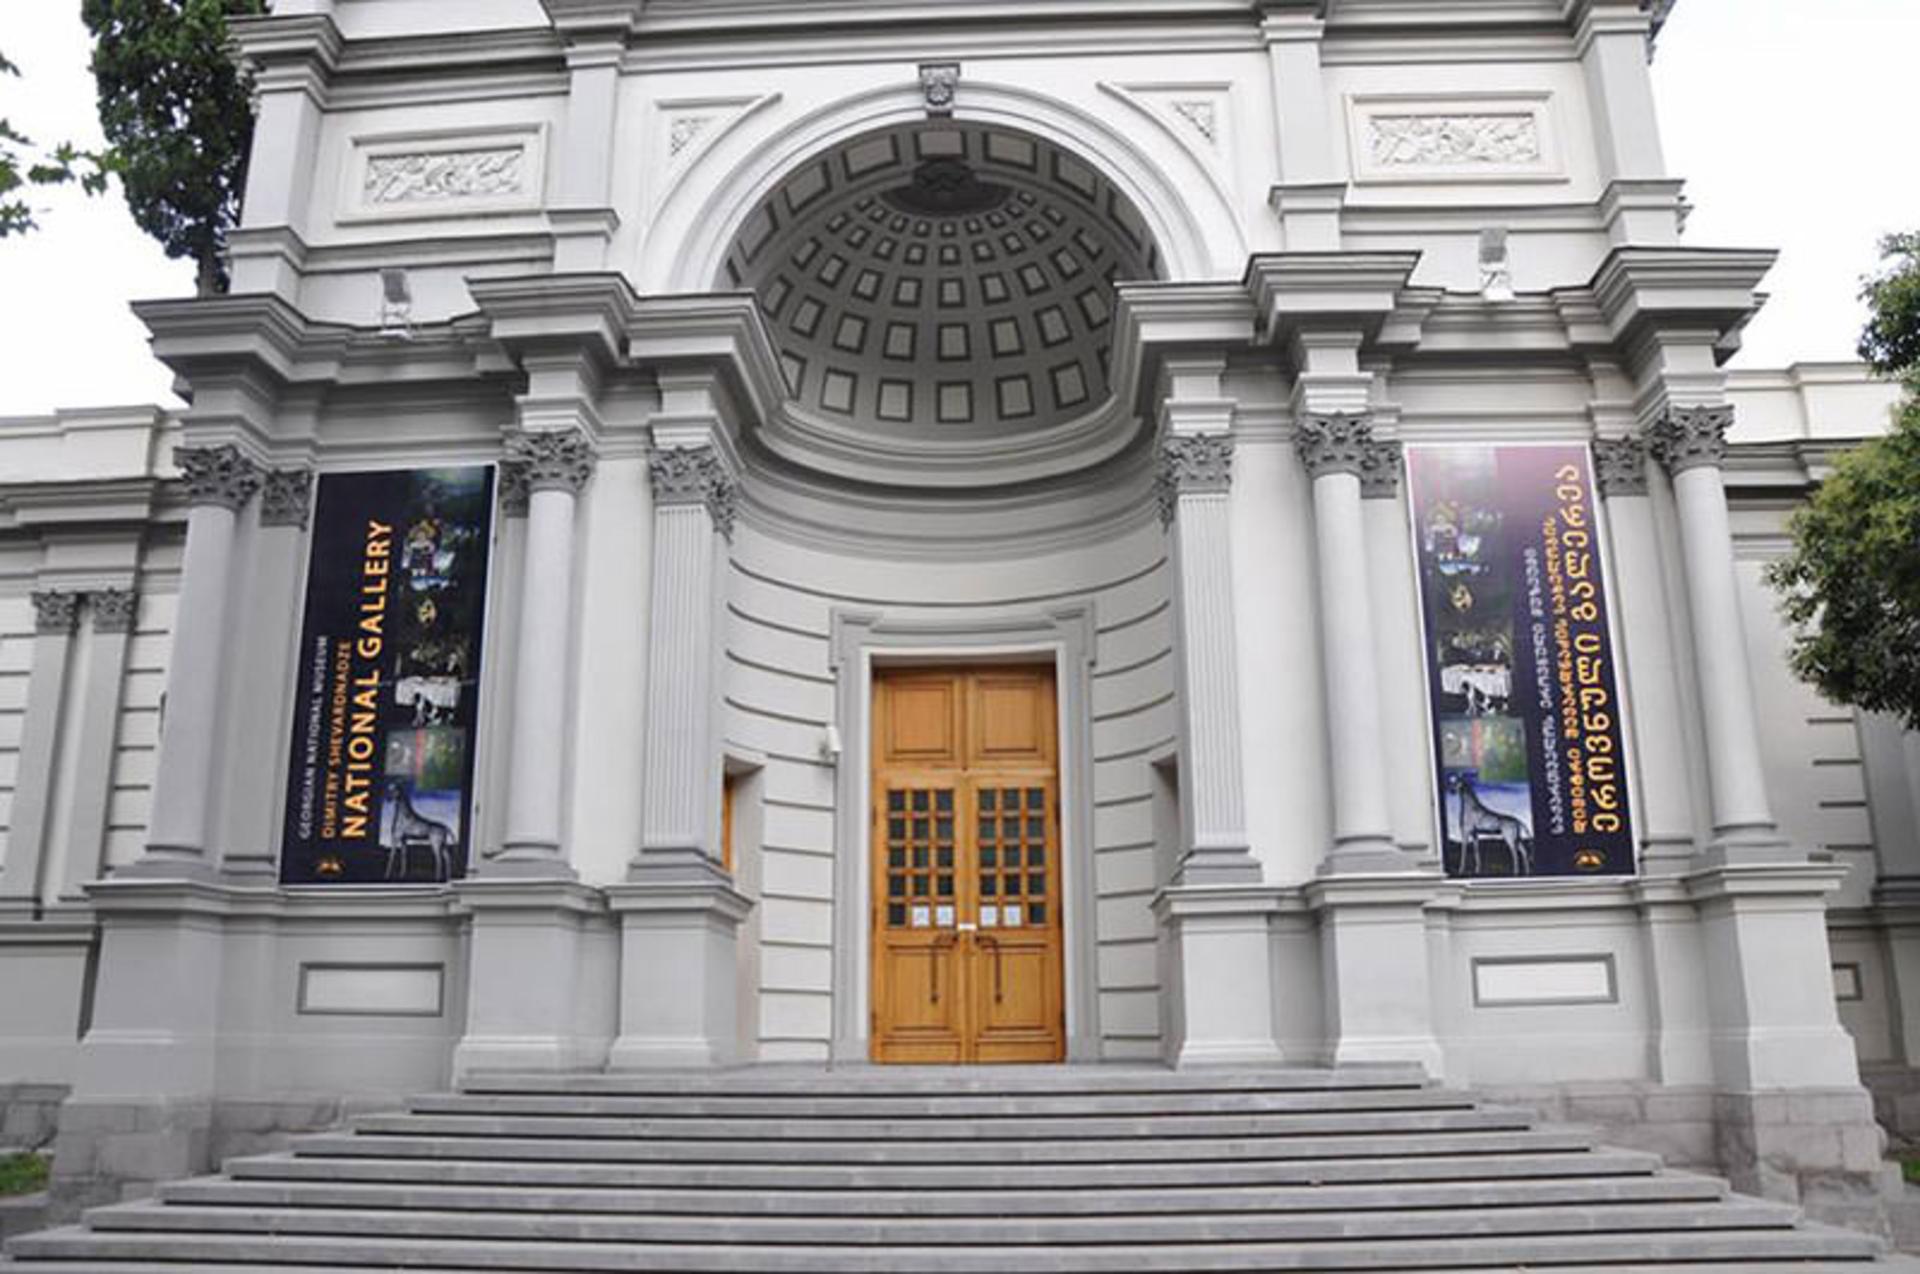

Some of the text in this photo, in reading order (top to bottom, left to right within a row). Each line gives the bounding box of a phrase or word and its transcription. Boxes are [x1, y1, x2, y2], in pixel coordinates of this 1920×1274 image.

[299, 636, 328, 838] GEORGIAN NATIONAL MUSEUM
[322, 642, 352, 838] DIMITRY SHEVARDNADZE
[342, 520, 393, 837] NATIONAL GALLERY
[1532, 622, 1552, 709] ეროვნული
[1555, 464, 1620, 833] ეროვნული გალერეა
[1566, 748, 1588, 833] დიმიტრი
